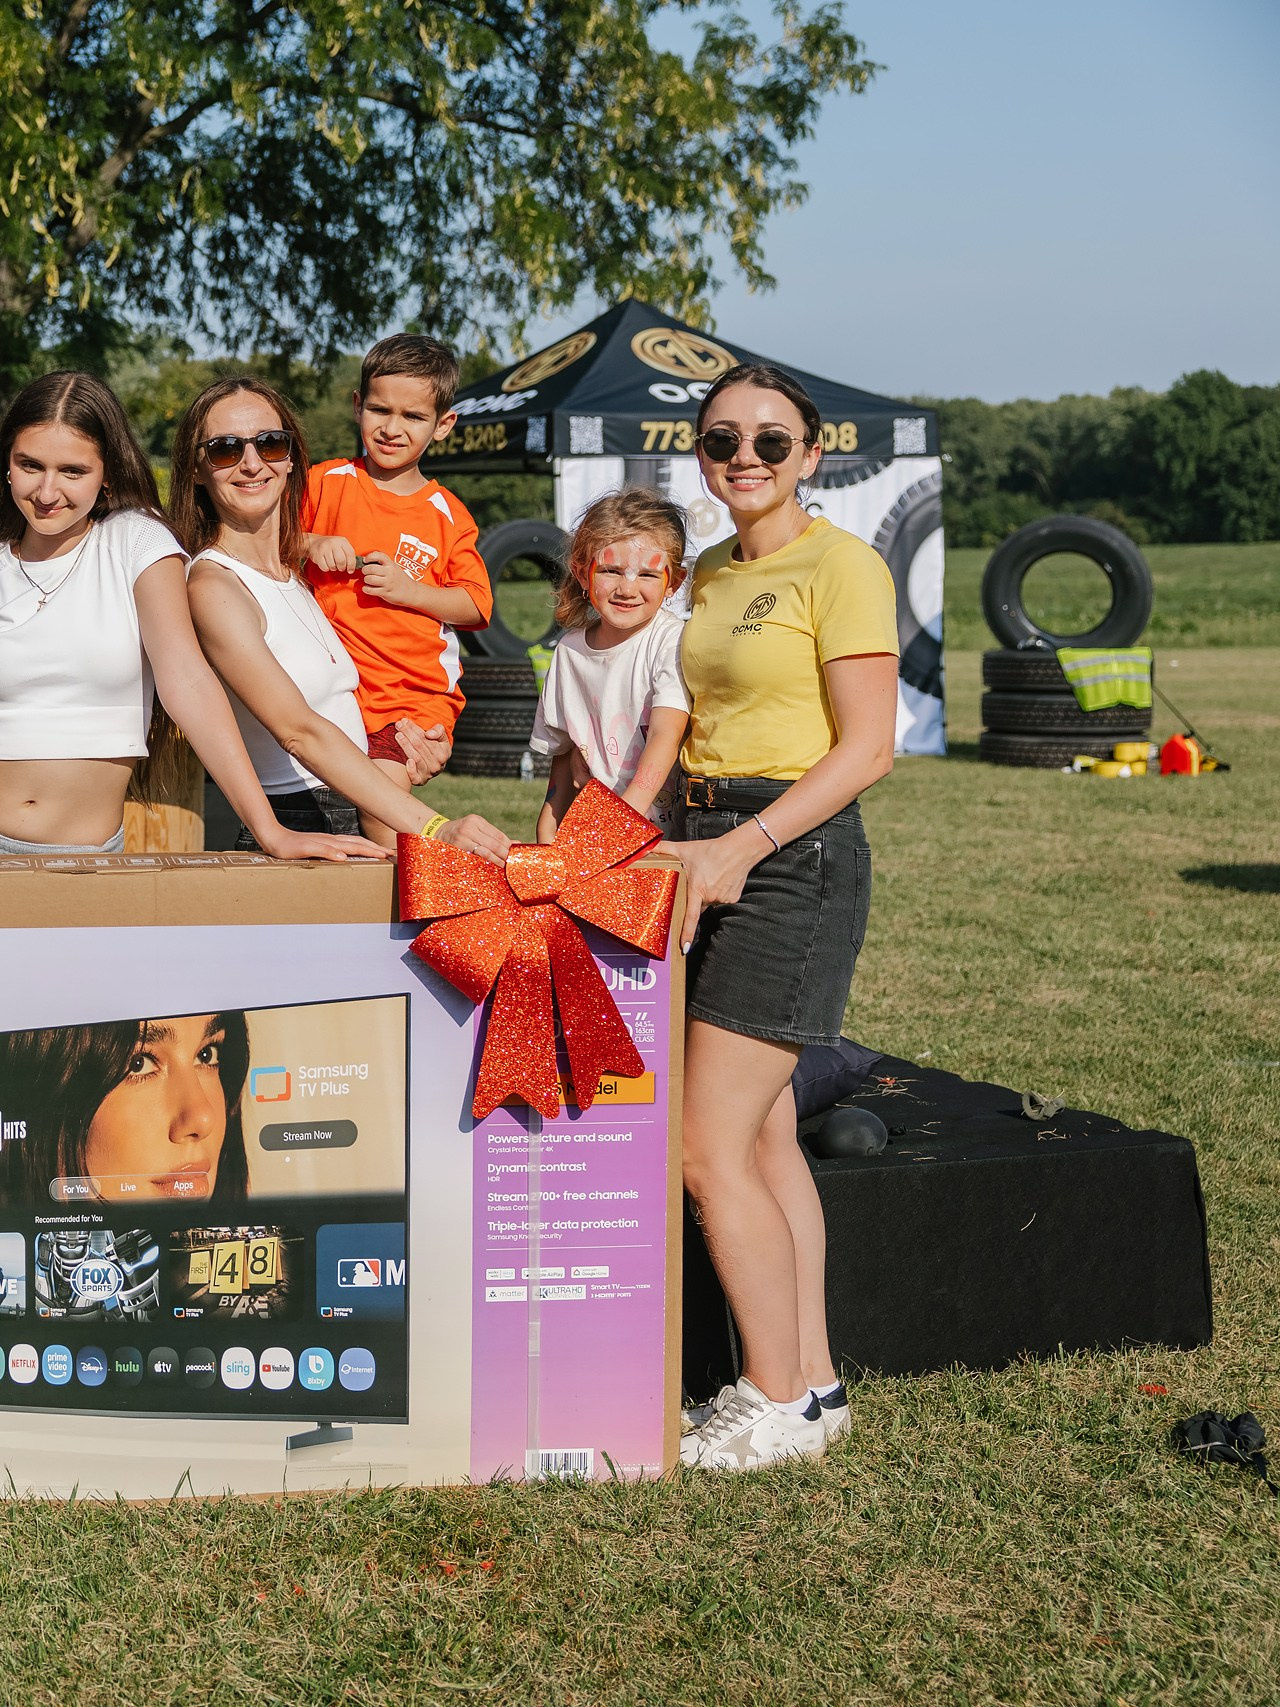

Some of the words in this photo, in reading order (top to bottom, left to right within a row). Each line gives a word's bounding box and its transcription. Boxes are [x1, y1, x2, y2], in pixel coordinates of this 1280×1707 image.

[398, 557, 424, 574] PRSC
[732, 623, 763, 634] OCMC
[298, 1062, 368, 1080] Samsung
[298, 1083, 315, 1097] TV
[321, 1082, 350, 1096] Plus
[567, 1082, 617, 1094] Mdel
[3, 1121, 27, 1140] HITS
[283, 1131, 312, 1142] Stream
[314, 1130, 332, 1141] Now
[488, 1135, 529, 1143] Powers
[574, 1133, 596, 1142] and
[598, 1132, 632, 1142] sound
[488, 1163, 538, 1175] Dynamic
[540, 1162, 586, 1171] contrast
[62, 1185, 74, 1194] For
[75, 1184, 89, 1194] You
[120, 1183, 136, 1192] Live
[173, 1180, 194, 1192] Apps
[488, 1193, 528, 1201] Stream
[563, 1190, 586, 1200] free
[589, 1190, 638, 1200] channels
[35, 1215, 80, 1224] Recommended
[552, 1220, 579, 1230] data
[581, 1218, 638, 1232] protection
[190, 1266, 207, 1274] FIRST
[82, 1268, 111, 1285] FOX
[219, 1296, 237, 1306] BY
[12, 1359, 36, 1368] NETFLIX
[47, 1353, 67, 1363] prime
[48, 1363, 67, 1371] video
[116, 1361, 140, 1373] hulu
[186, 1363, 213, 1374] peacock
[226, 1361, 250, 1375] sling
[308, 1377, 325, 1386] Bixby
